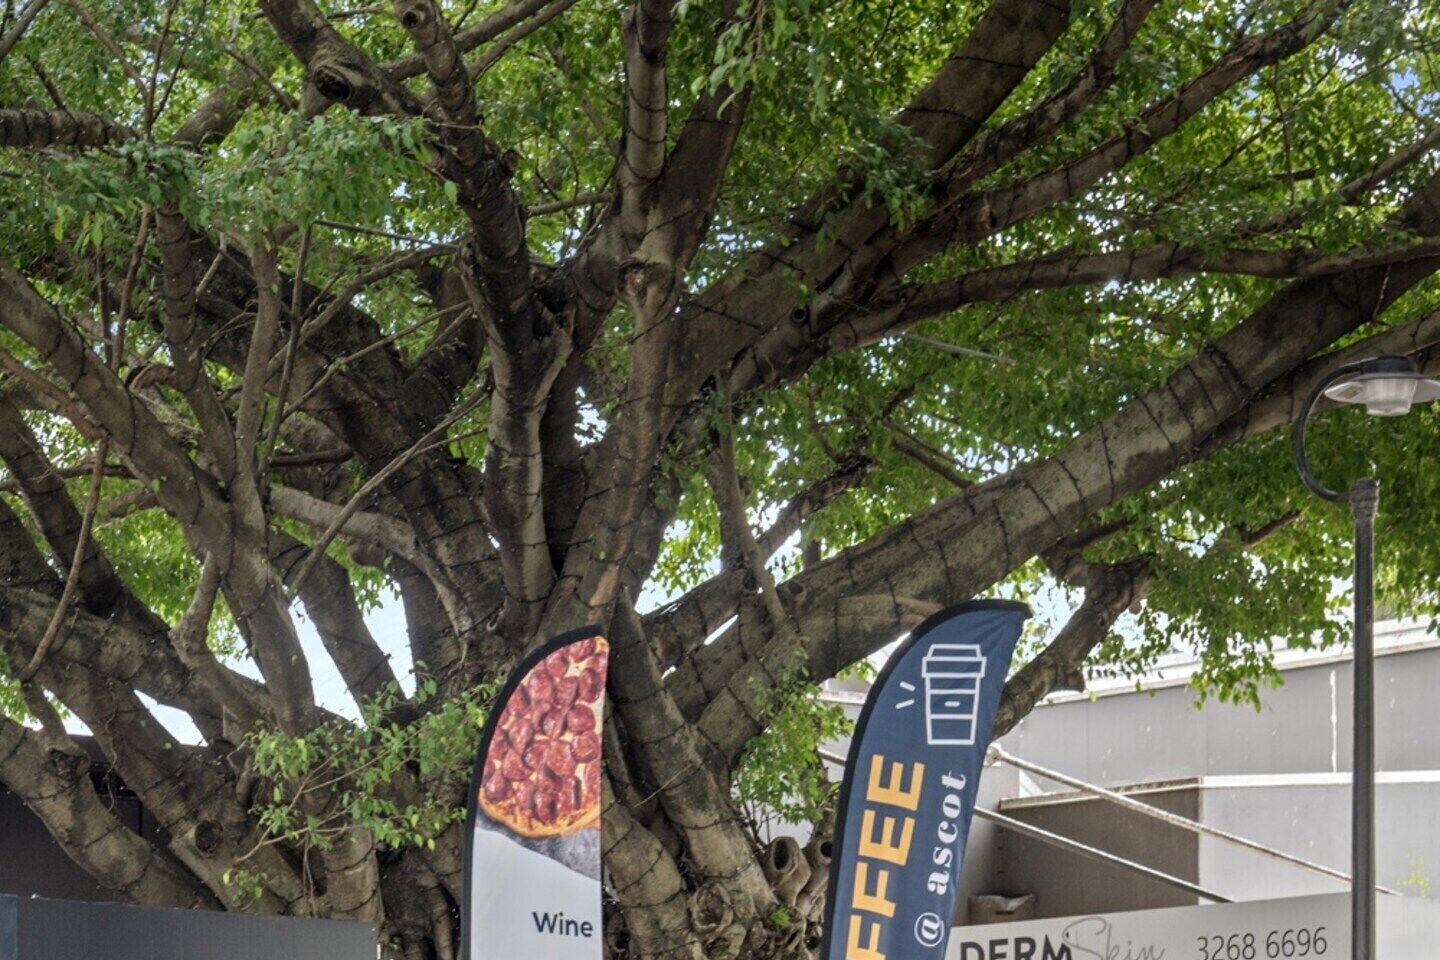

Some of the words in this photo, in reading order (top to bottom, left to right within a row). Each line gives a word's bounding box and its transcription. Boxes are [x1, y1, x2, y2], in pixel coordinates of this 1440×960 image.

[926, 770, 967, 896] ascot
[532, 911, 594, 938] Wine
[914, 912, 945, 947] @
[1265, 926, 1328, 959] 6696
